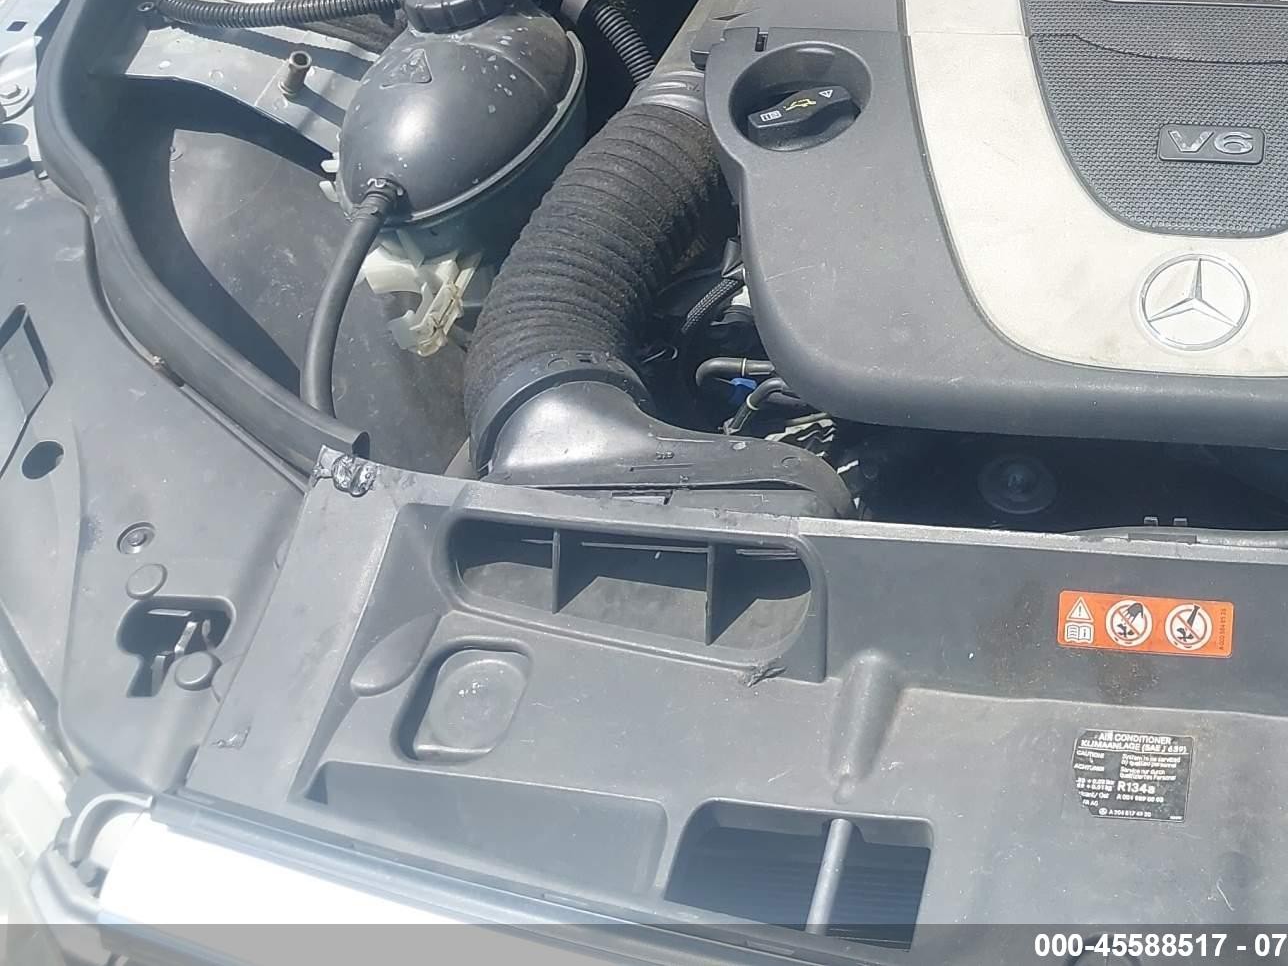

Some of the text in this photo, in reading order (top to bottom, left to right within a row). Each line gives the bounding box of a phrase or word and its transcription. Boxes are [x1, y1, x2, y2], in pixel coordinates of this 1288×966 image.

[1167, 130, 1253, 155] V6
[1080, 739, 1141, 751] KLIMAANLAGE
[1098, 732, 1172, 745] AIR CONDITIONER
[1117, 780, 1156, 794] R134a
